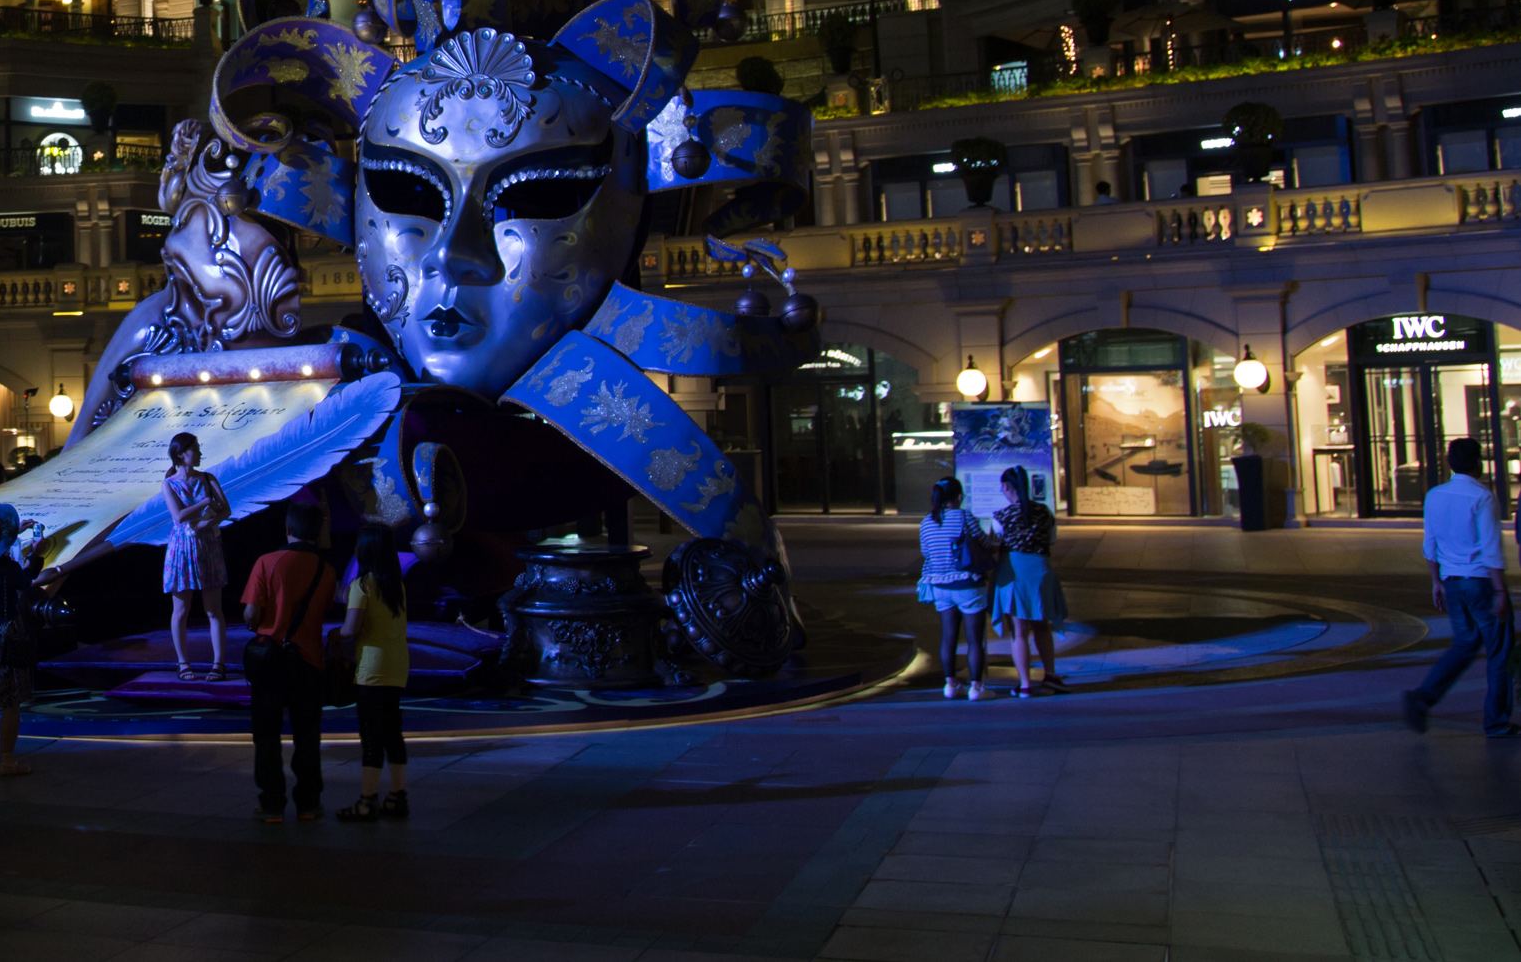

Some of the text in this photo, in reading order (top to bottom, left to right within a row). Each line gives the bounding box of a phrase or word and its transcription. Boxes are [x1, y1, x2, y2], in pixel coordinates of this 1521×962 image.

[141, 214, 171, 227] ROGER
[321, 271, 356, 286] 188
[1392, 316, 1447, 340] IWC
[1376, 340, 1466, 354] SCHAFFHAUSEN
[134, 406, 192, 421] William
[197, 402, 286, 431] Shakespeare
[1203, 410, 1243, 428] IWC
